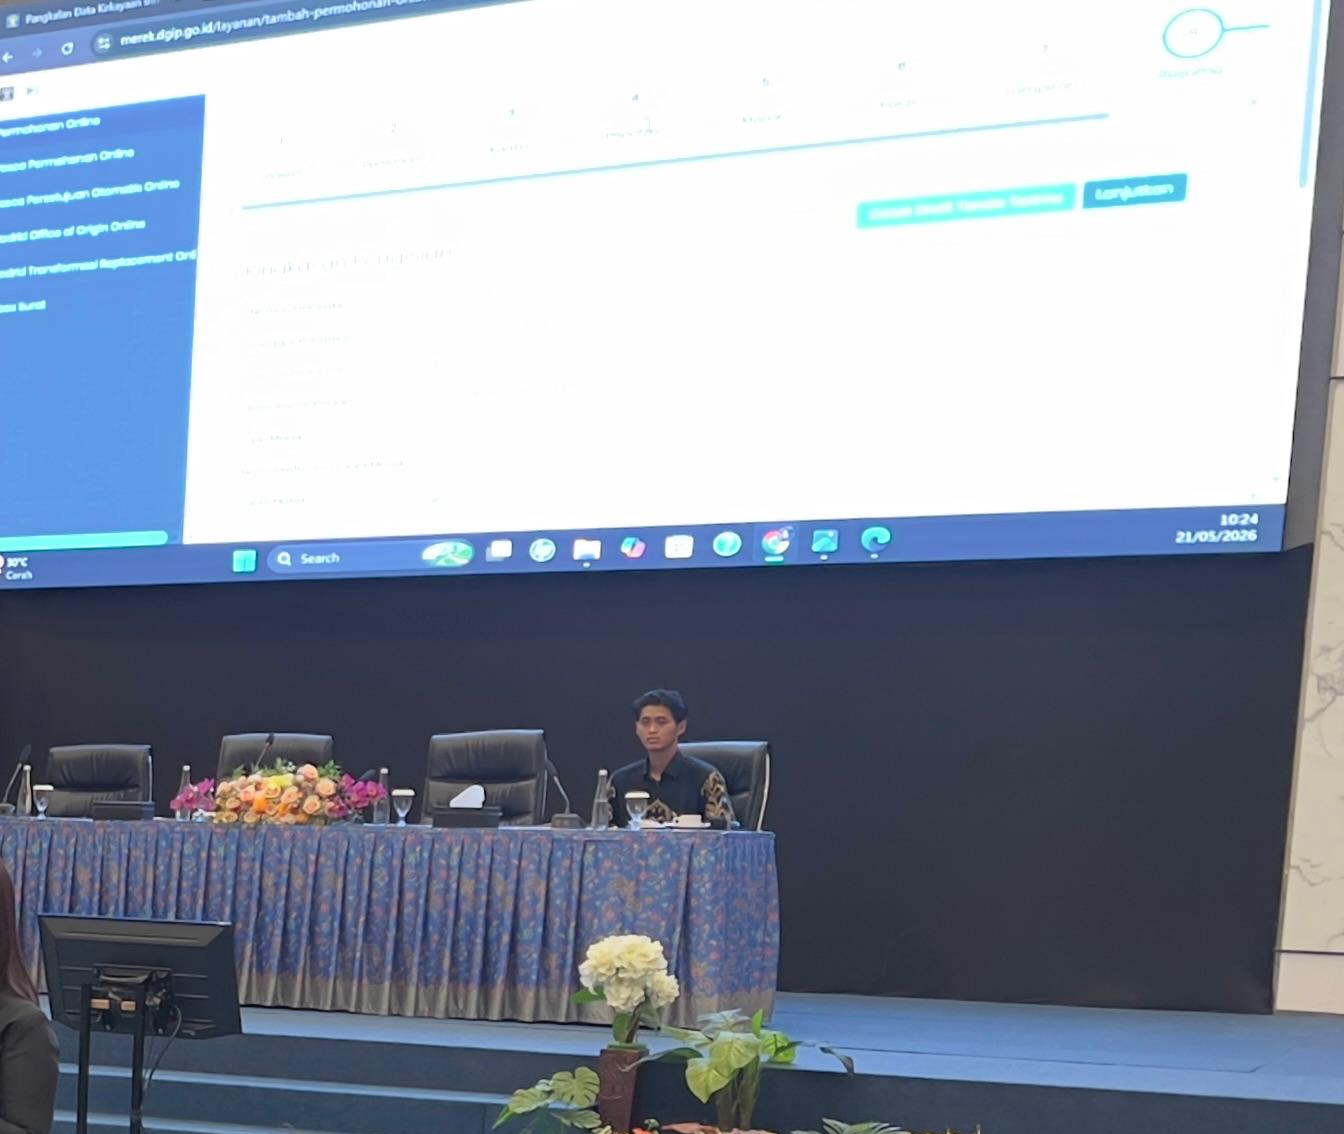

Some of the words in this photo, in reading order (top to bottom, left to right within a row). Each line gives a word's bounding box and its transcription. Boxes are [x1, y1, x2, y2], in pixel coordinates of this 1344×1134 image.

[29, 228, 62, 240] Office
[63, 226, 75, 237] of
[110, 219, 146, 232] Online
[1220, 513, 1259, 526] 10:24
[1175, 529, 1258, 544] 21/05/2026
[300, 551, 340, 565] Search
